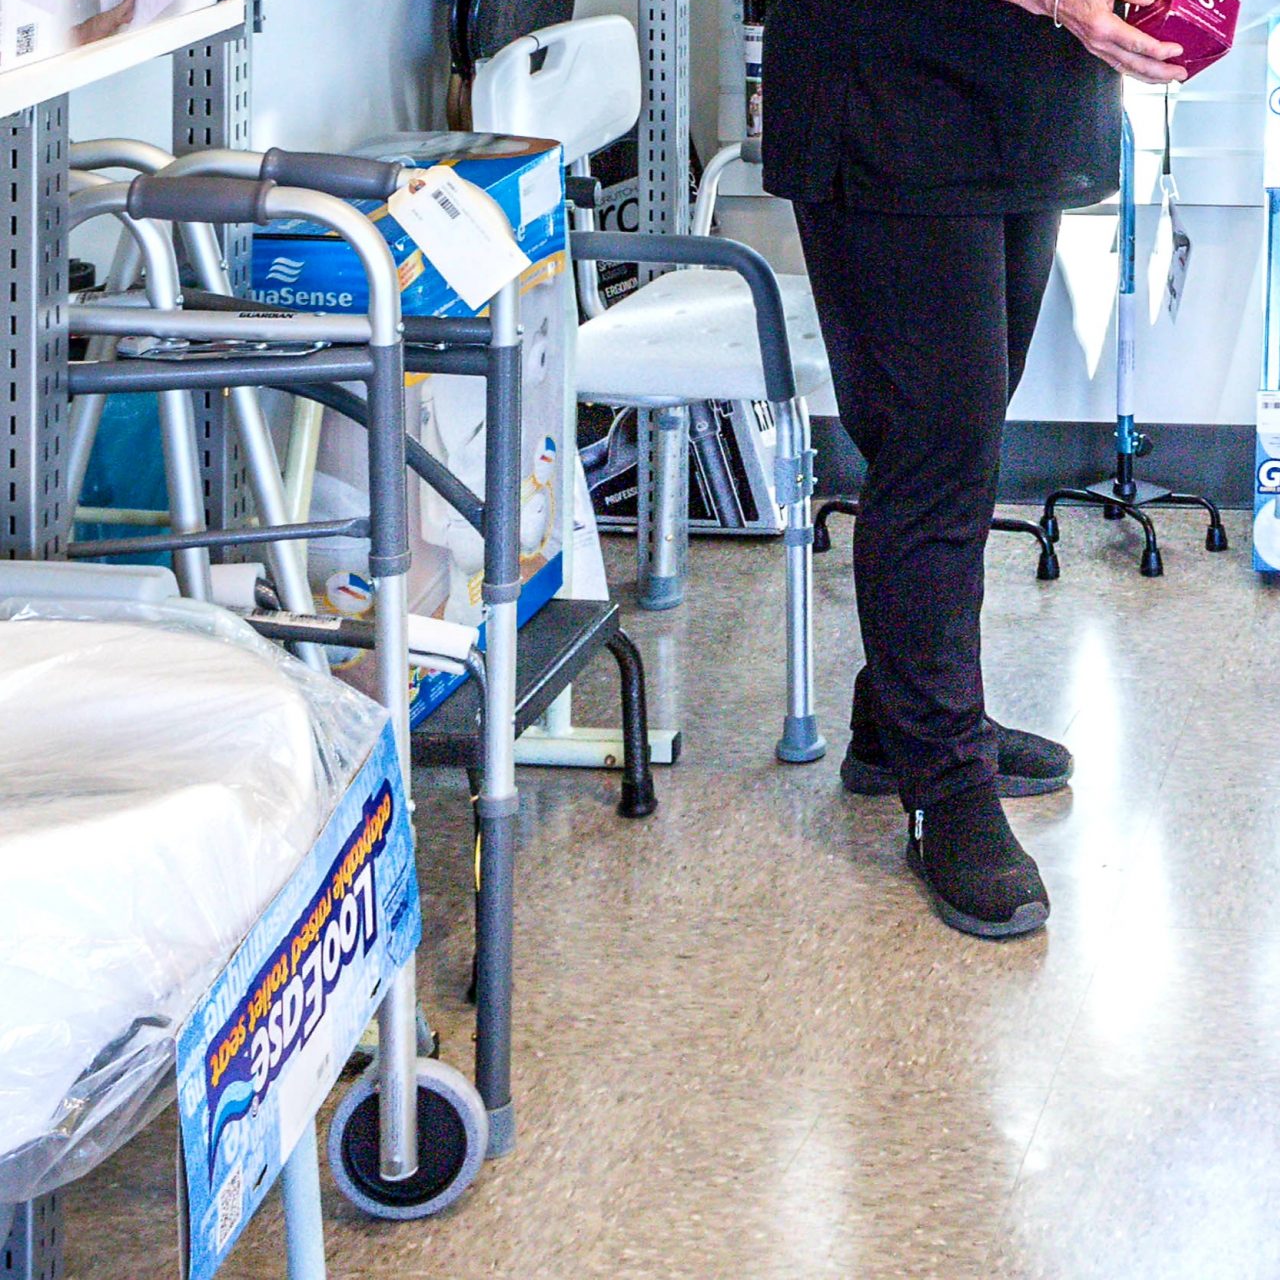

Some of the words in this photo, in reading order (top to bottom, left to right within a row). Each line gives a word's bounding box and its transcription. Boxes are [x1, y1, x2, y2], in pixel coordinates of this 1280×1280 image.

[238, 311, 295, 319] GUARDIAN
[250, 287, 353, 307] uaSense
[333, 793, 391, 900] adaptable
[291, 887, 333, 976] raised
[248, 953, 289, 1033] toilet
[251, 861, 375, 1094] LooEase
[210, 1015, 247, 1088] seat
